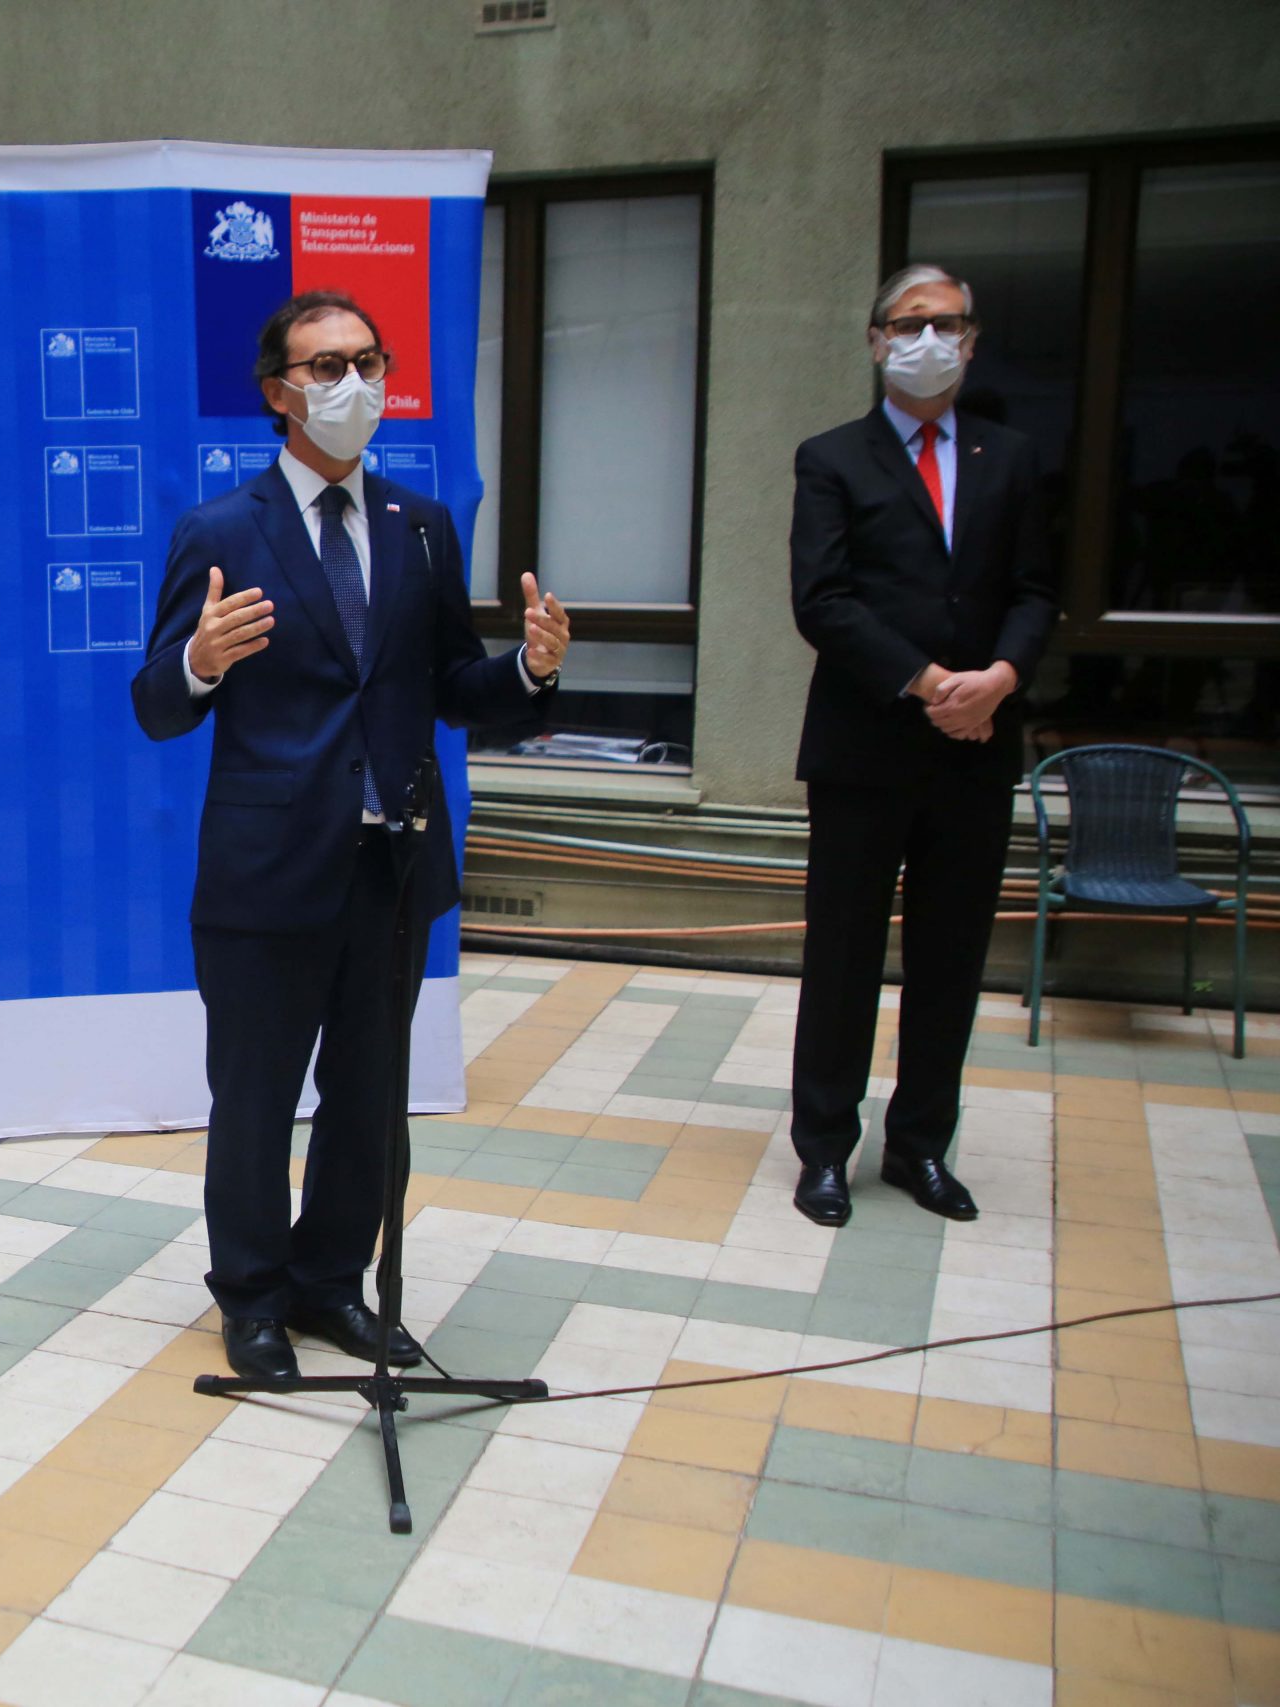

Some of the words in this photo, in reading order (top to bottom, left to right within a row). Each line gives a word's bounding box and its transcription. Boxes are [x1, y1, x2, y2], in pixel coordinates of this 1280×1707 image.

[300, 212, 360, 225] Ministerio
[362, 213, 377, 225] de
[301, 225, 366, 240] Transportes
[369, 230, 377, 242] y
[301, 240, 415, 253] Telecomunicaciones
[387, 395, 420, 409] Chile
